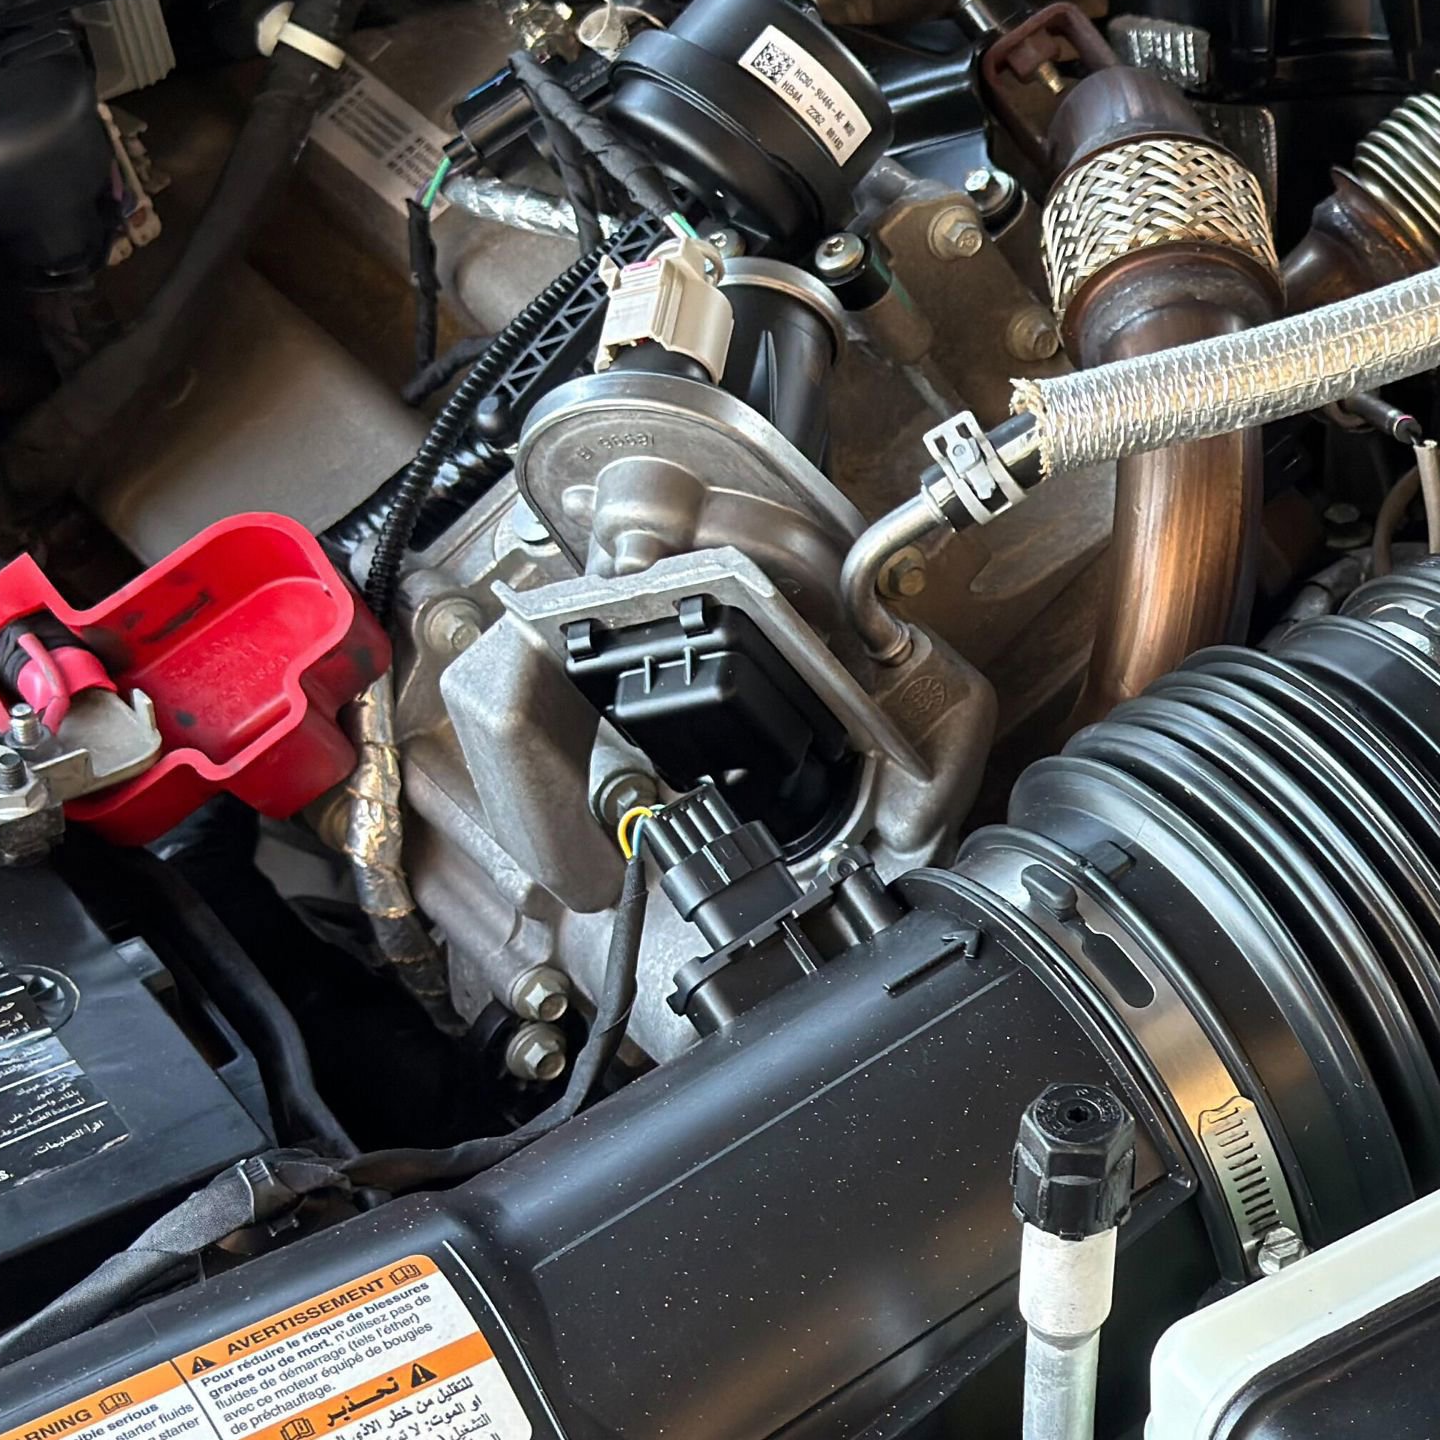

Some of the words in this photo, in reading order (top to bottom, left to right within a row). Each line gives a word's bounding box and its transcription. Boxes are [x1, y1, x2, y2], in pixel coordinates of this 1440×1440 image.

[199, 1366, 235, 1389] Pour
[235, 1345, 287, 1373] réduire
[284, 1338, 302, 1351] le
[300, 1319, 346, 1344] risque
[345, 1310, 365, 1324] de
[362, 1281, 431, 1316] blessures
[226, 1276, 385, 1357] AVERTISSEMENT
[105, 1402, 160, 1432] serious
[157, 1403, 196, 1425] fluids
